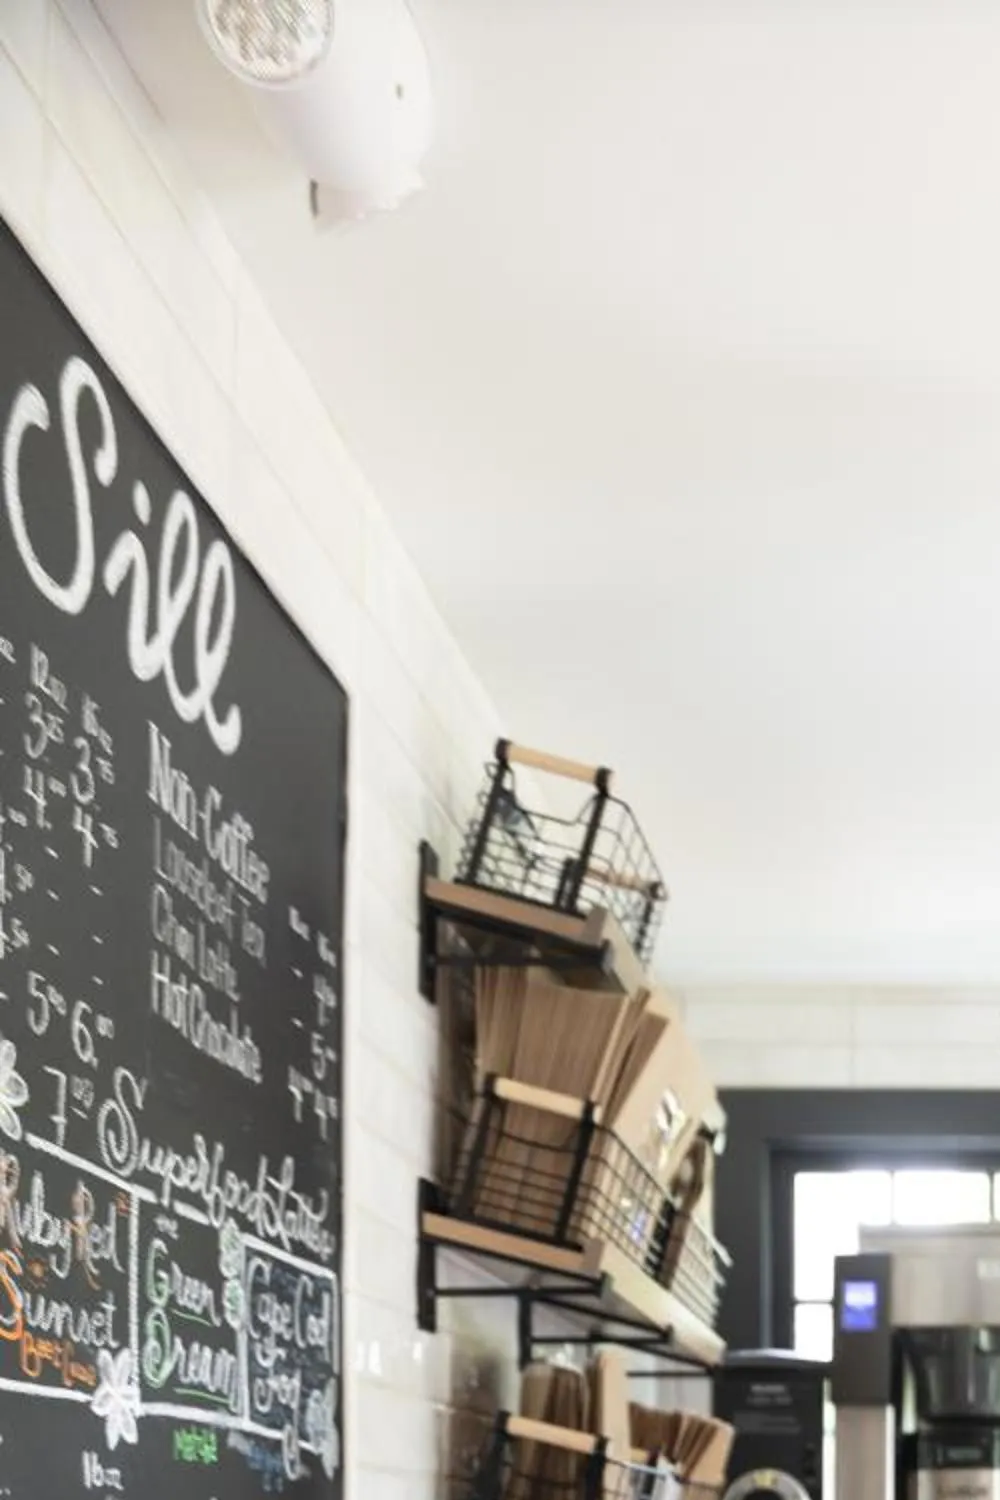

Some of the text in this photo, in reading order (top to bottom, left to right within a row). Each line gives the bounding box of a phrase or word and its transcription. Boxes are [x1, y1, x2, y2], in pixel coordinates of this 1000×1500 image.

[5, 356, 242, 755] Sill
[0, 1250, 120, 1350] Sunset
[147, 1238, 222, 1328] Green
[142, 1307, 245, 1415] Dream
